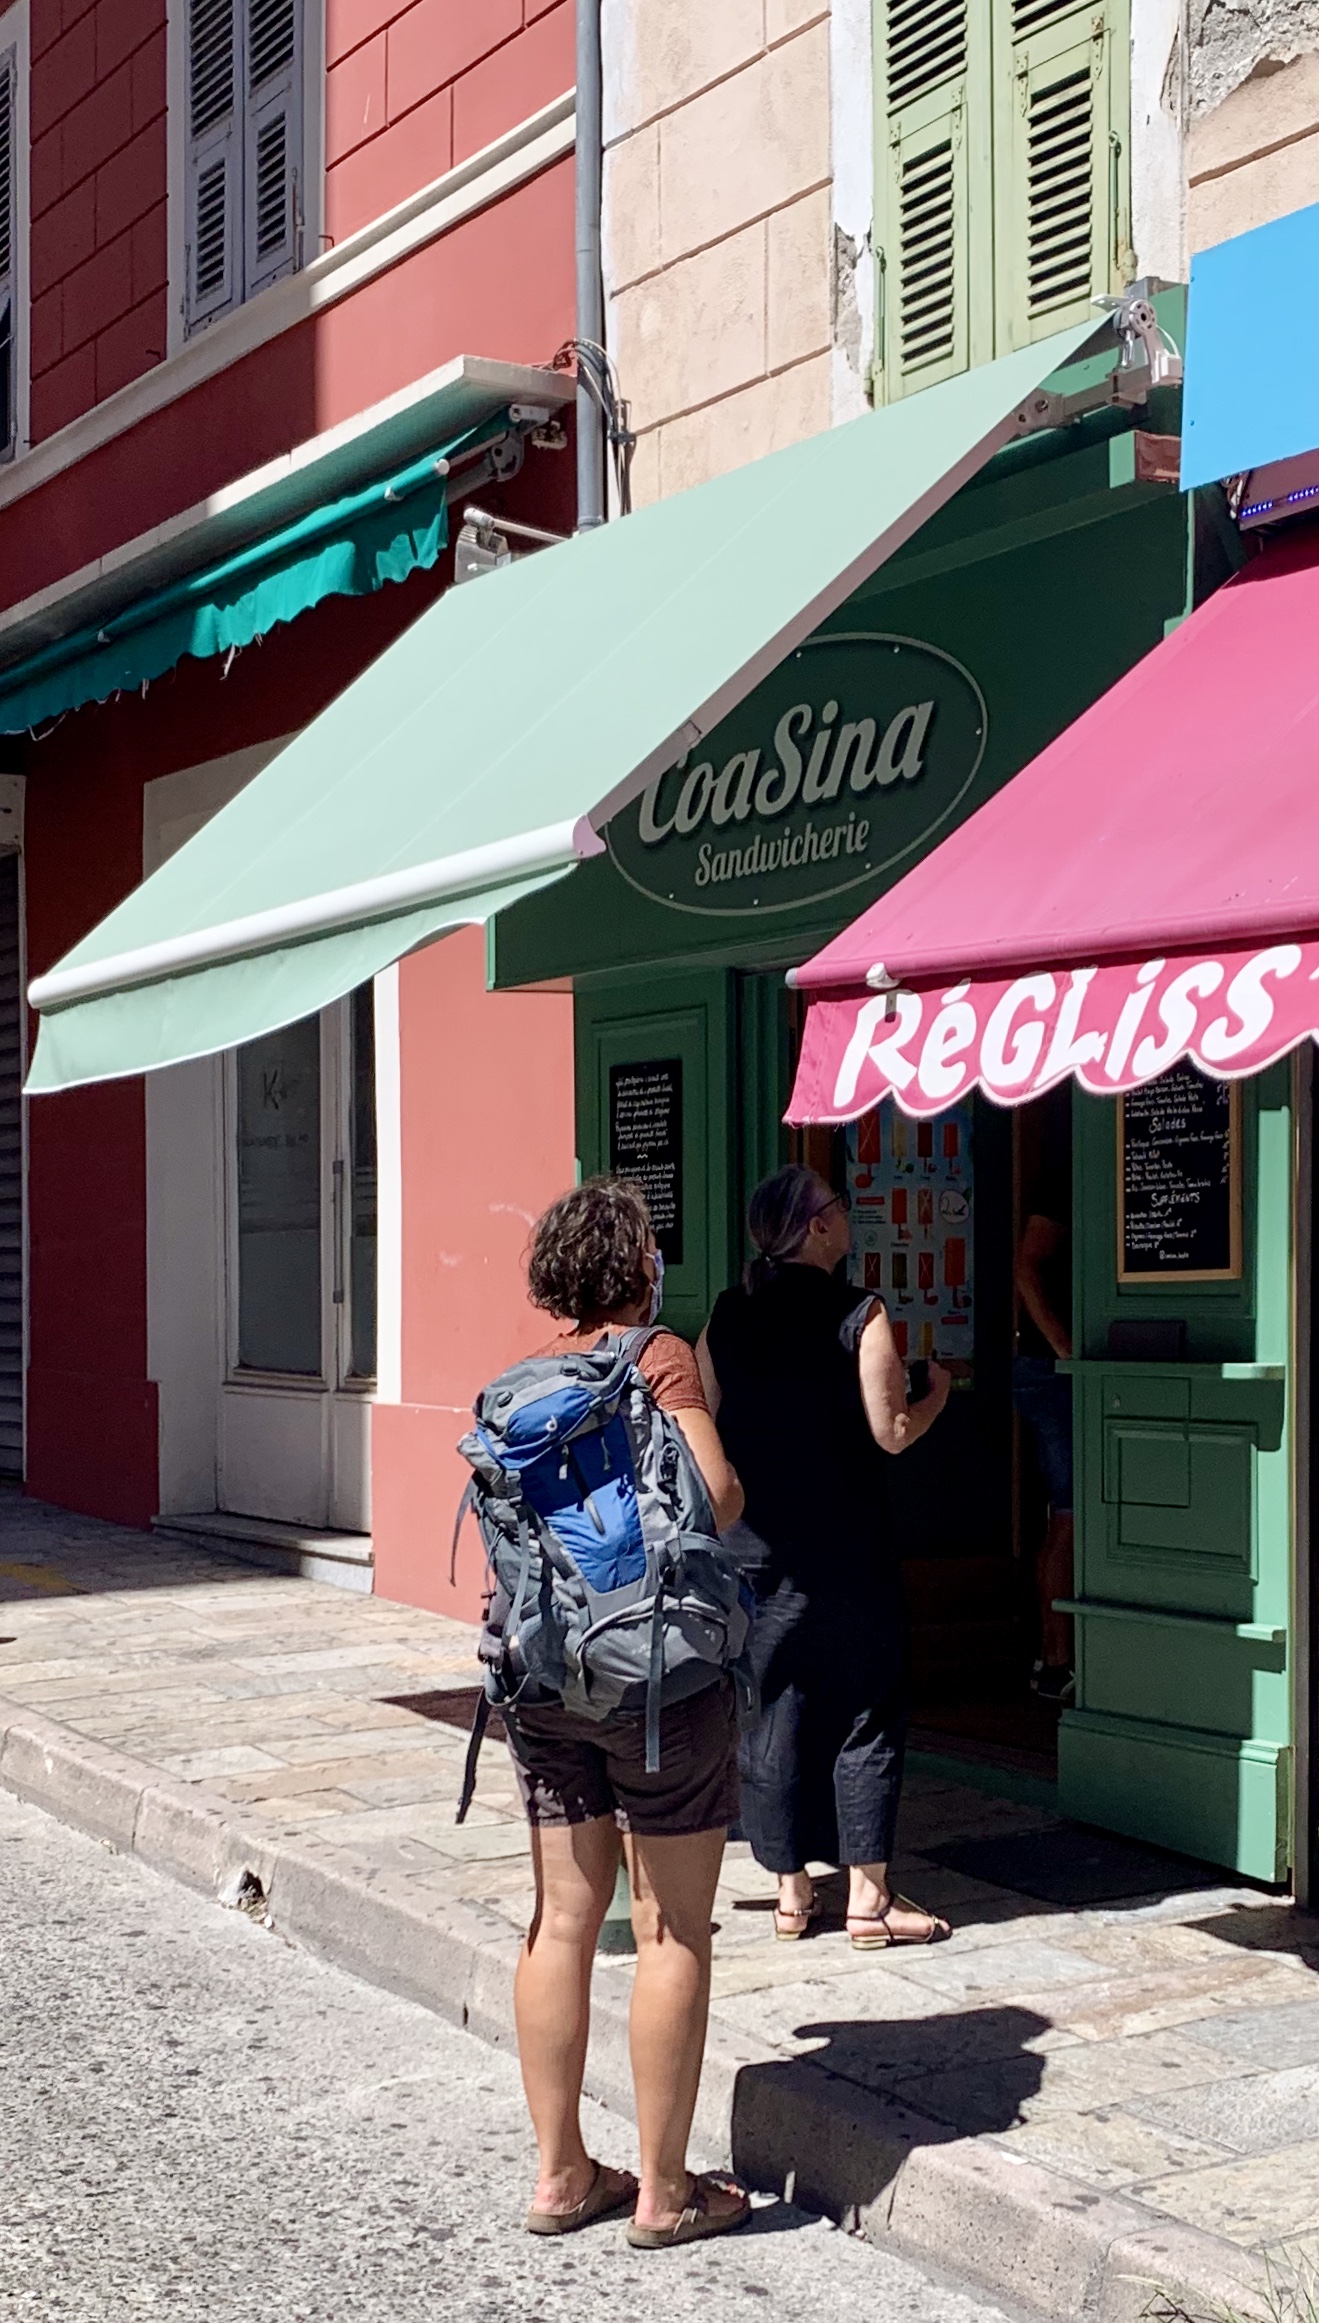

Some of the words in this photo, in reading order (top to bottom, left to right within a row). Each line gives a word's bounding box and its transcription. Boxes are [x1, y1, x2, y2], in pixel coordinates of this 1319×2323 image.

[638, 700, 935, 843] CoaSina
[694, 812, 870, 886] Sandwicherie
[1148, 1117, 1187, 1134] Salades
